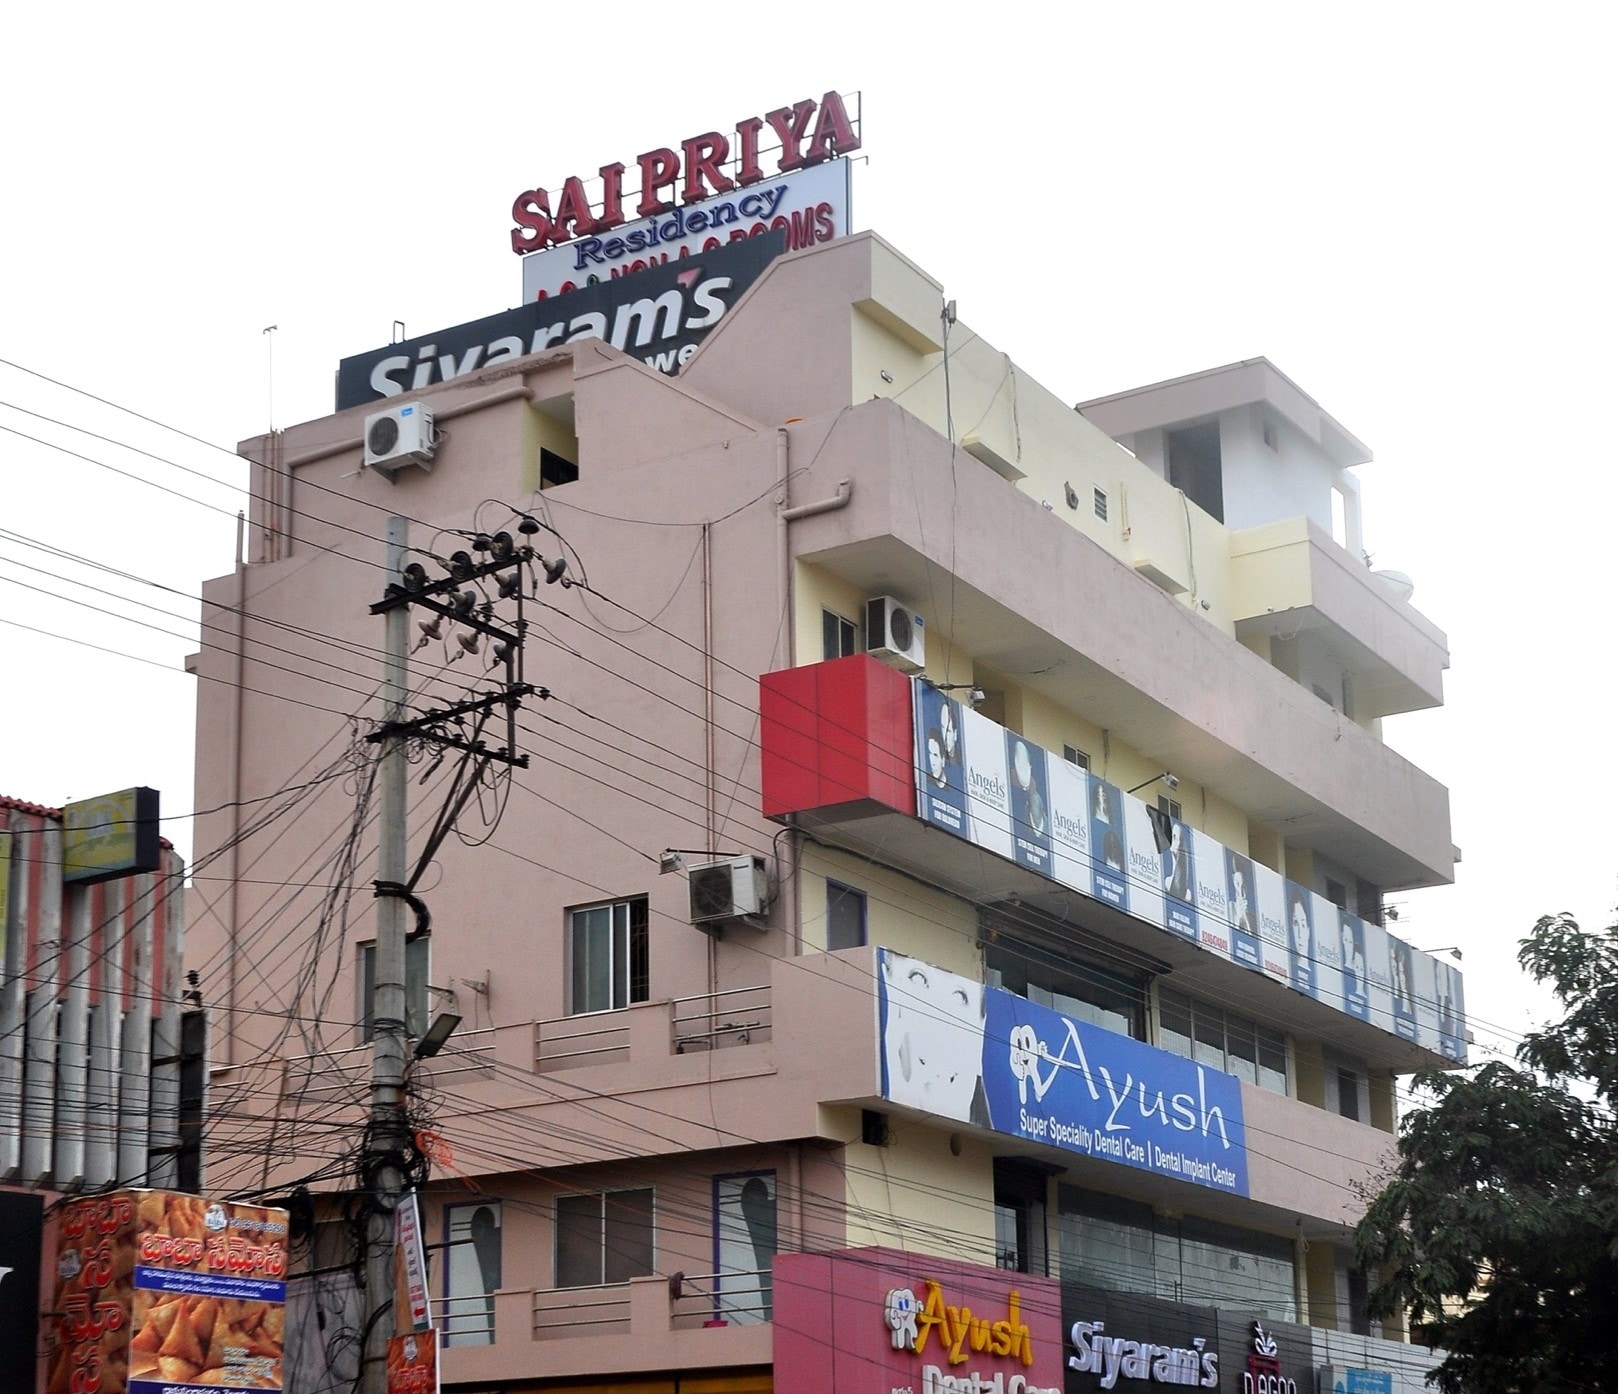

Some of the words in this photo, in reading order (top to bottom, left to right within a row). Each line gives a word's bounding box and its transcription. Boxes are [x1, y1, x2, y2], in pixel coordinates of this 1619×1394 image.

[511, 160, 625, 256] SAI
[636, 90, 862, 218] PRIYA
[574, 184, 788, 271] Residency
[968, 765, 1006, 799] Angels
[1053, 808, 1087, 839] Angels
[1128, 847, 1160, 874] Angels
[1199, 880, 1226, 906] Angels
[1036, 1017, 1231, 1149] Ayush
[1019, 1108, 1048, 1139] Super
[1050, 1116, 1093, 1154] Speciality
[1095, 1129, 1123, 1157] Dental
[1124, 1137, 1145, 1162] Care
[1155, 1146, 1181, 1172] Dental
[1182, 1153, 1210, 1181] Implant
[1211, 1162, 1236, 1188] Center
[140, 1233, 204, 1265] బాబా
[914, 1278, 1034, 1366] Ayush
[1069, 1321, 1219, 1389] Siyaram's
